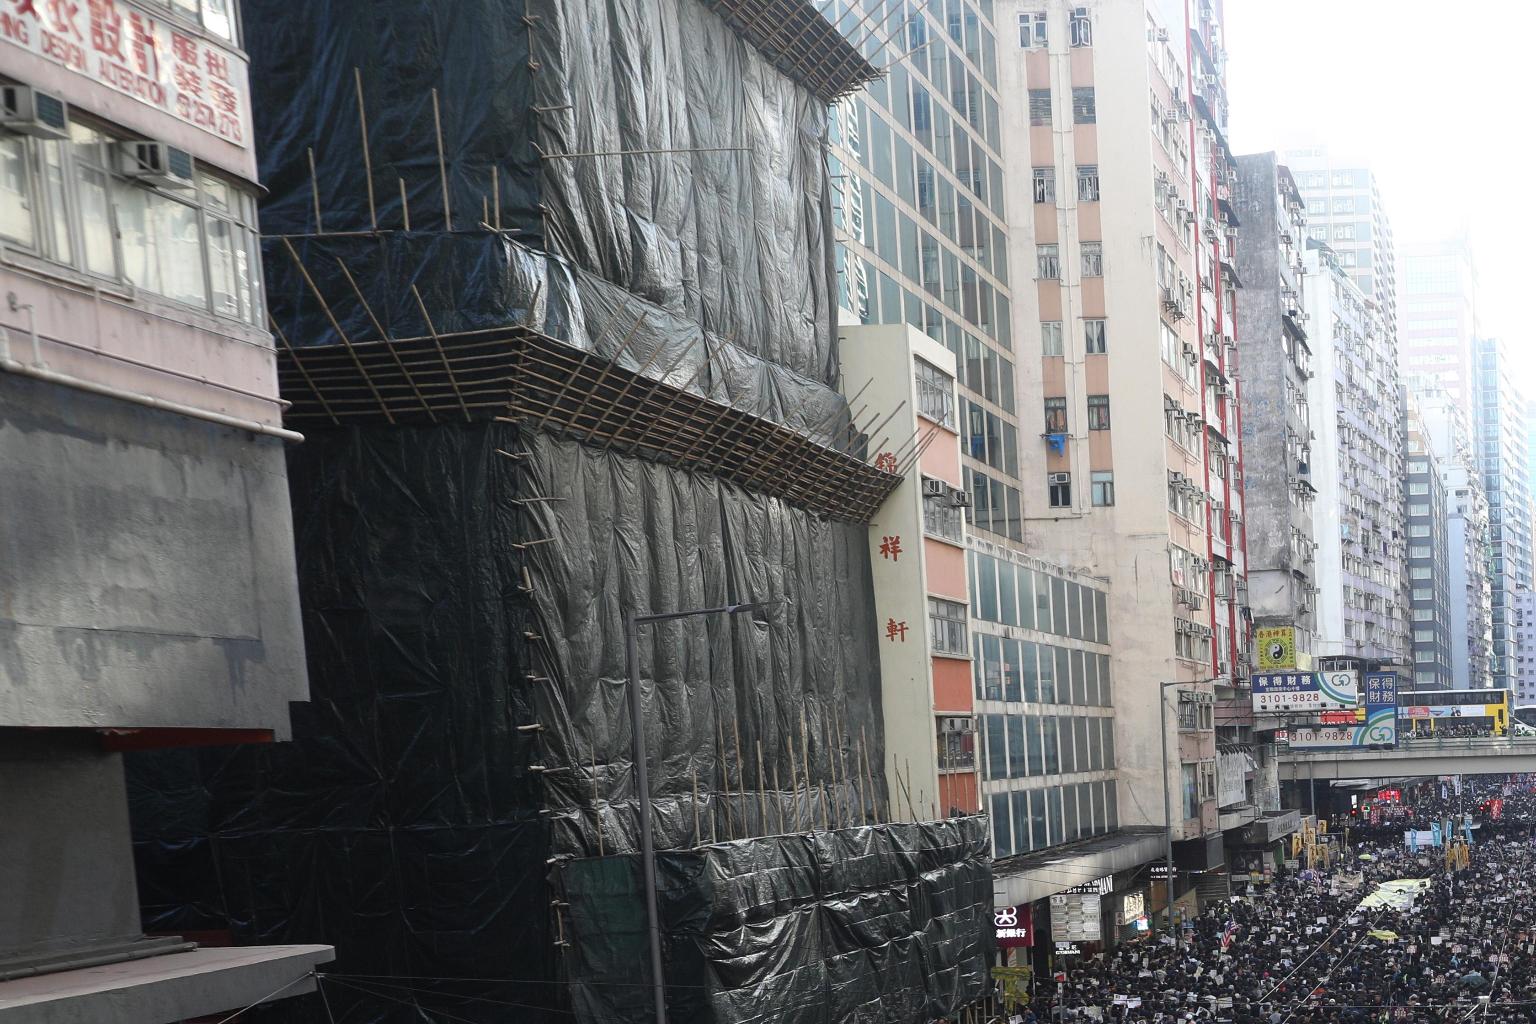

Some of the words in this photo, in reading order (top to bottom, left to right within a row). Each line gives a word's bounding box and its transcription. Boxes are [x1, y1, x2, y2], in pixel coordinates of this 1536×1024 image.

[1258, 676, 1311, 687] 保得財務
[1369, 678, 1393, 690] 保得
[1260, 693, 1319, 704] 3101-9828
[1369, 691, 1393, 703] 財務
[1291, 731, 1353, 742] 3101-9828
